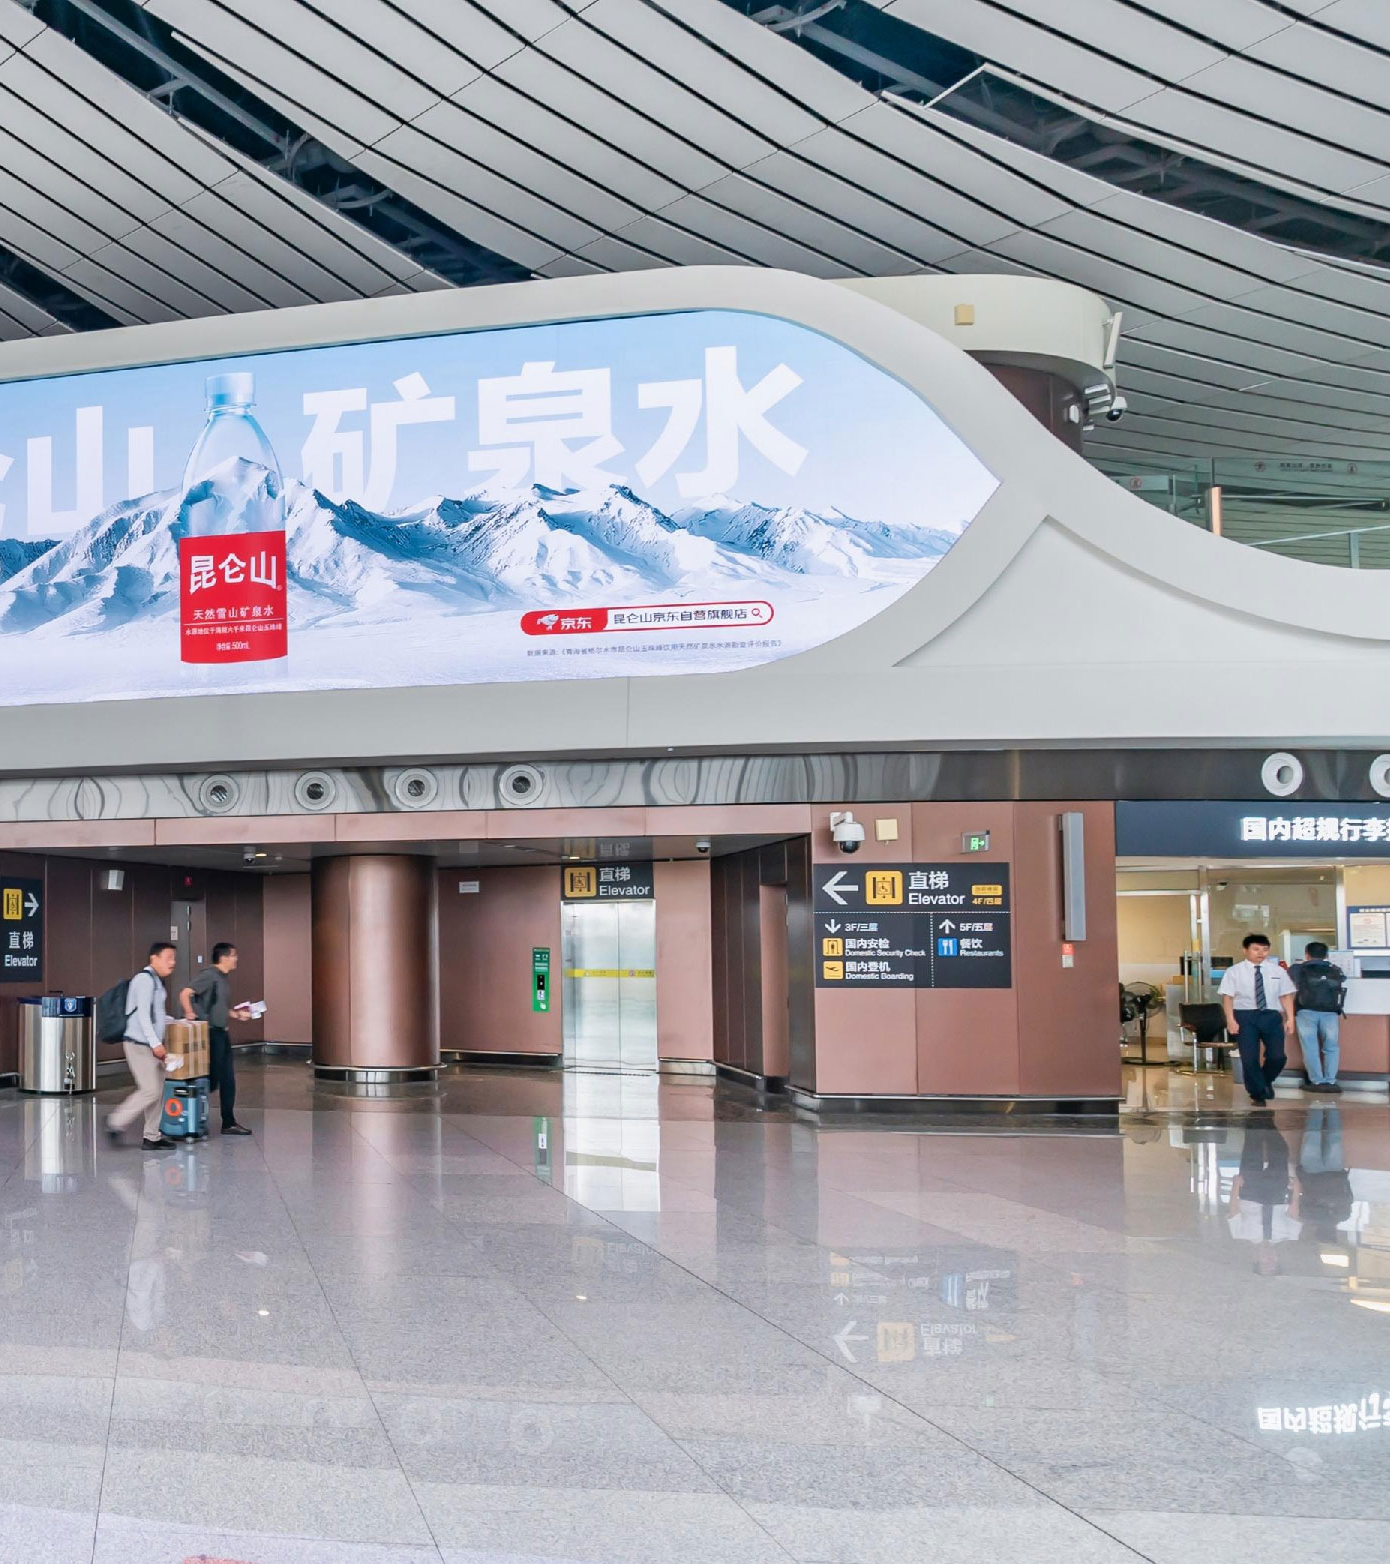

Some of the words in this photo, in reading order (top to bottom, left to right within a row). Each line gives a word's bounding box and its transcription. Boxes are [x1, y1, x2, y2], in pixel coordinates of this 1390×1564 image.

[301, 345, 809, 512] 矿泉水
[189, 550, 278, 595] 昆仑山
[193, 604, 274, 620] 天然雪山矿泉水
[613, 608, 748, 625] 昆仑山京东自营旗舰店
[560, 616, 593, 630] 京东
[1241, 816, 1390, 842] 国内超规行李
[599, 866, 631, 882] 直梯
[908, 870, 949, 890] 直梯
[599, 884, 651, 896] Elevator
[908, 893, 966, 905] Elevator
[845, 922, 878, 932] 3F/三层
[960, 922, 993, 932] 5F/五层
[8, 930, 34, 949] 直梯
[845, 938, 890, 949] 国内安检
[960, 938, 983, 949] 餐饮
[845, 949, 876, 957] Domestic
[877, 949, 903, 958] Security
[905, 949, 926, 957] Check
[960, 949, 1004, 957] Restaurants
[4, 954, 38, 967] Elevator
[845, 961, 891, 972] 国内登机
[846, 972, 879, 980] Domestic
[881, 972, 914, 981] Boarding
